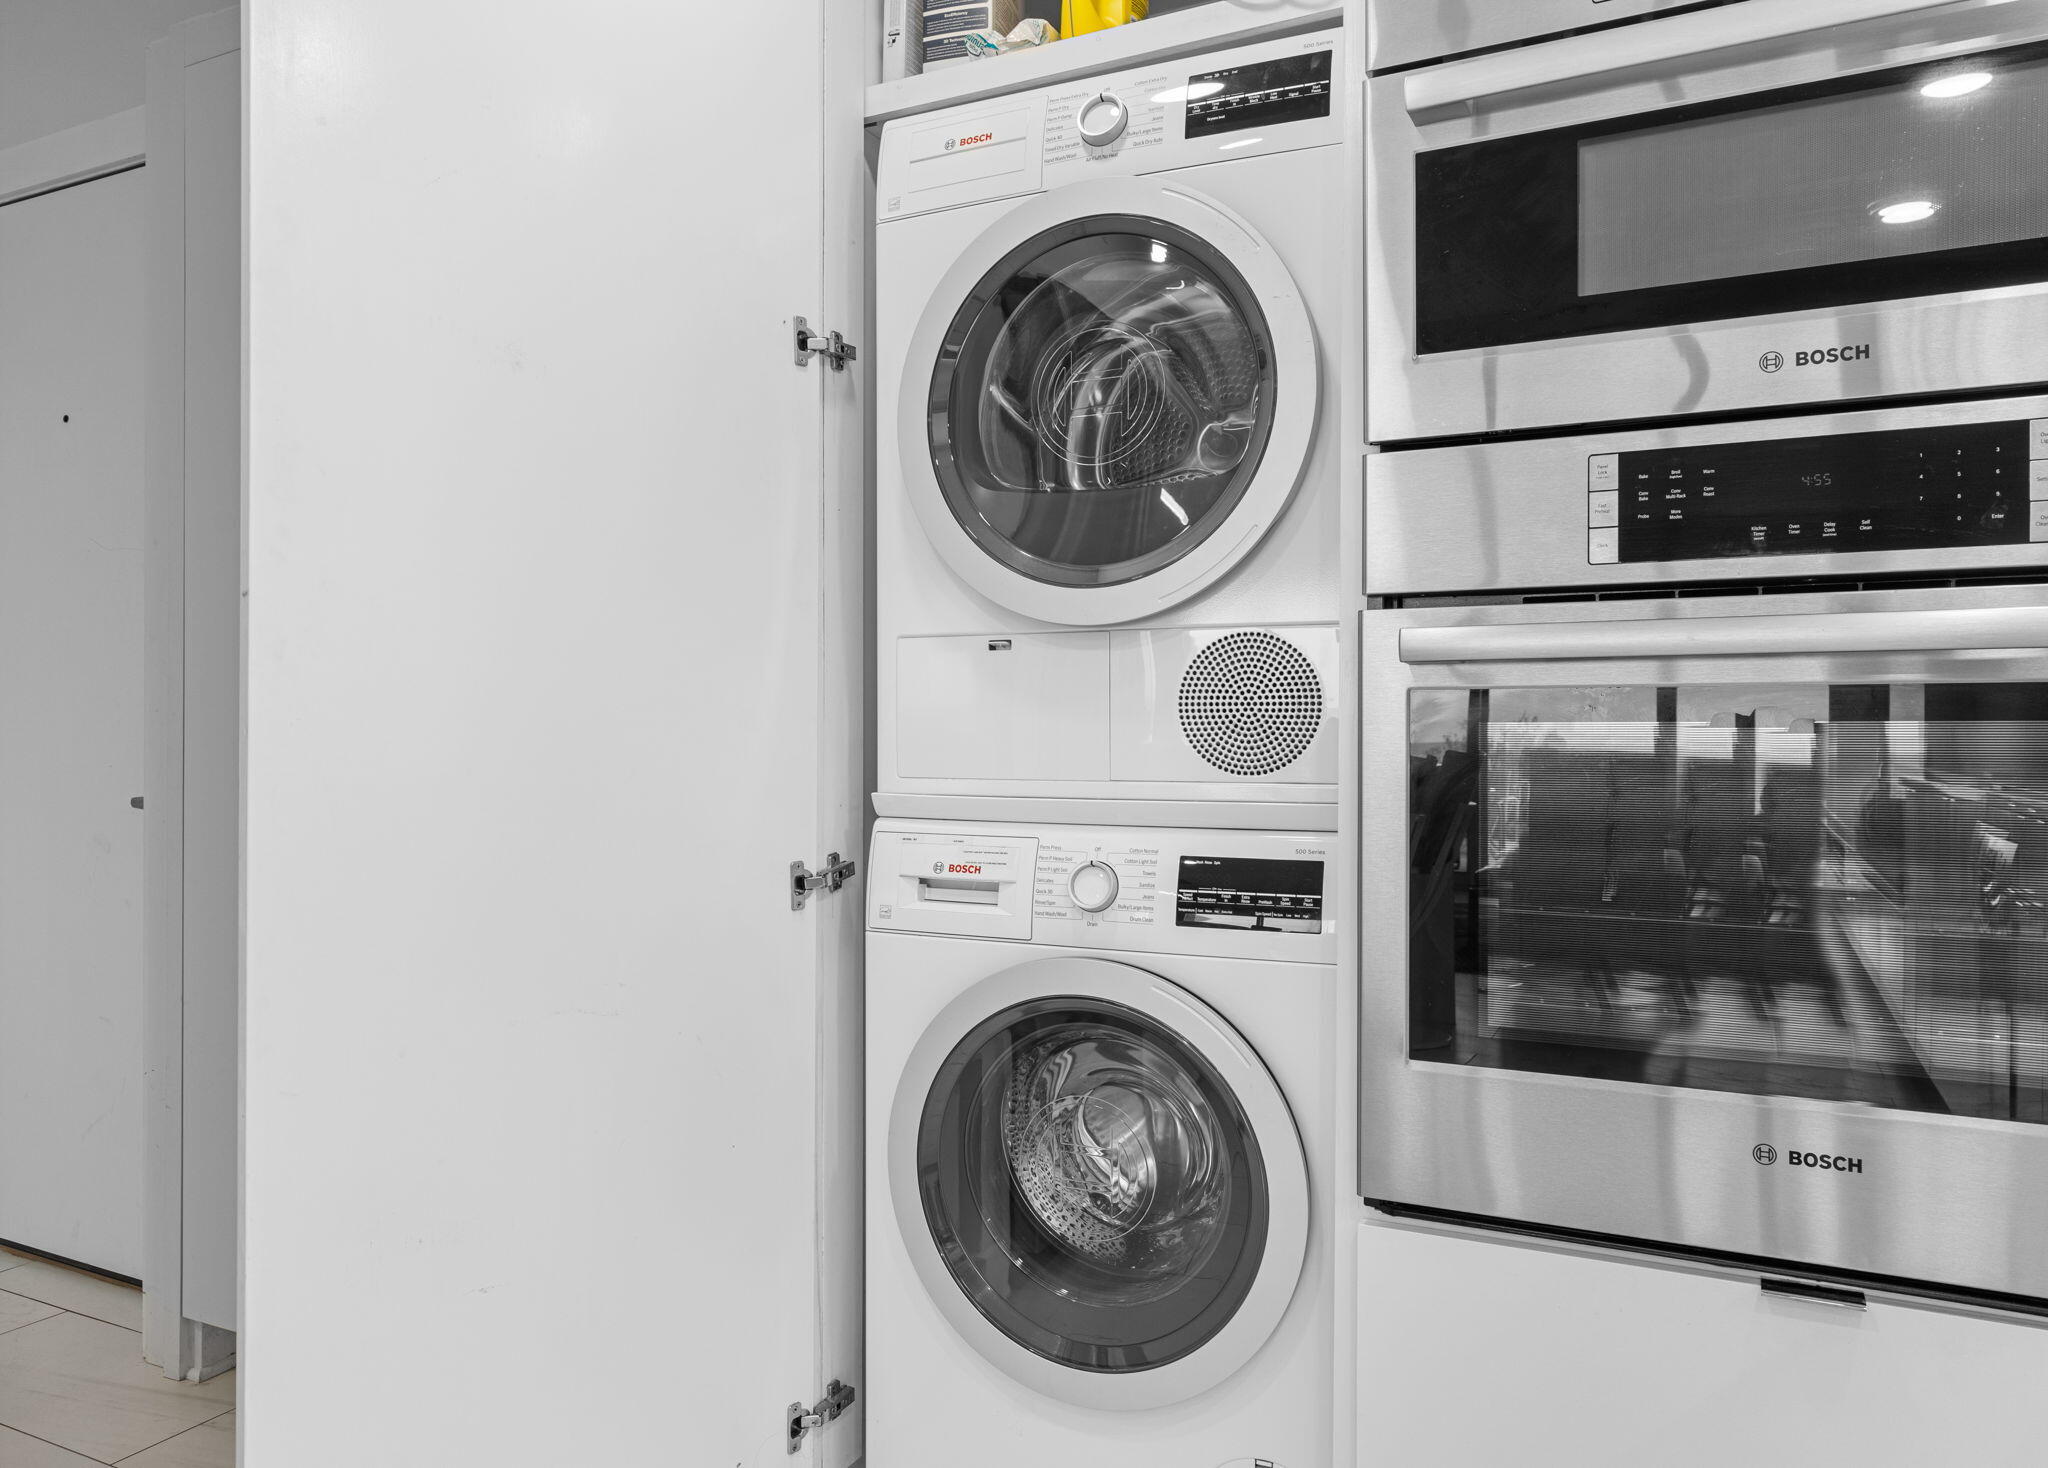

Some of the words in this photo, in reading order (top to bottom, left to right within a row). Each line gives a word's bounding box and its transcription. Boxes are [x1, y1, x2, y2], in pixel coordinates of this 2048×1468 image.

[960, 132, 992, 146] BOSCH
[1796, 344, 1870, 366] BOSCH
[1801, 473, 1831, 486] 4:55
[948, 864, 982, 874] BOSCH
[1788, 1150, 1862, 1174] BOSCH
